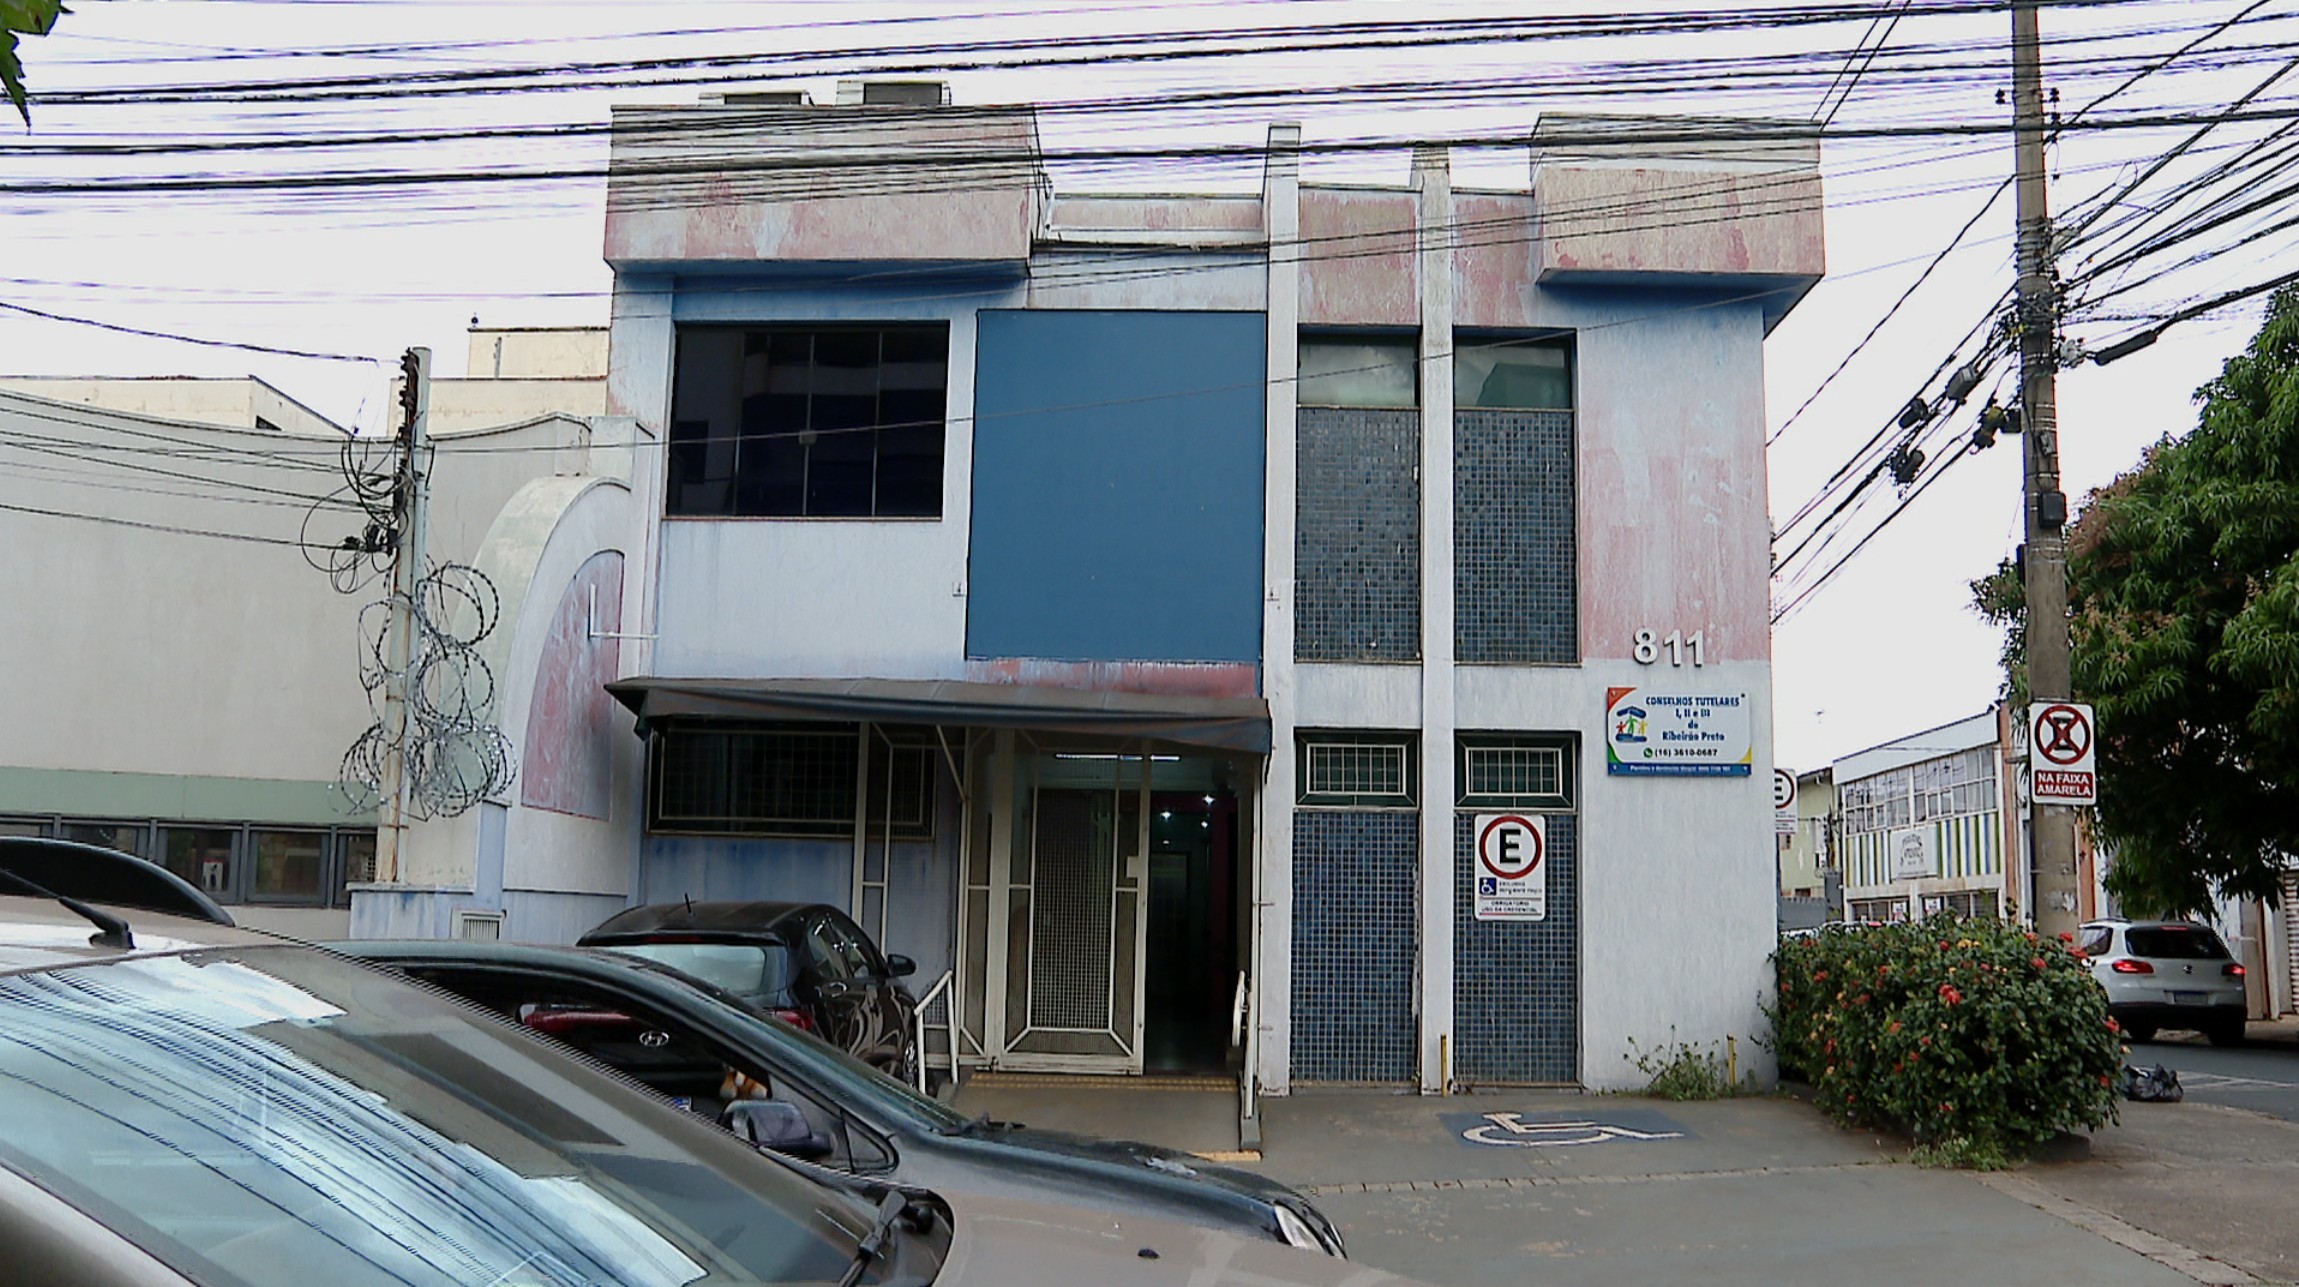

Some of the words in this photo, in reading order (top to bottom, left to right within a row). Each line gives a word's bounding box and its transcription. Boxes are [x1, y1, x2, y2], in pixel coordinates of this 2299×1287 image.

[1634, 628, 1704, 667] 811
[1645, 696, 1693, 706] CONSELHOS
[1695, 697, 1740, 706] TUTELARES
[1662, 731, 1699, 741] Ribeirão
[1701, 731, 1725, 741] Preto
[1655, 748, 1671, 758] (16)
[2037, 772, 2054, 782] NA
[2056, 773, 2089, 784] FAIXA
[2037, 784, 2091, 796] AMARELA
[1500, 829, 1521, 863] E
